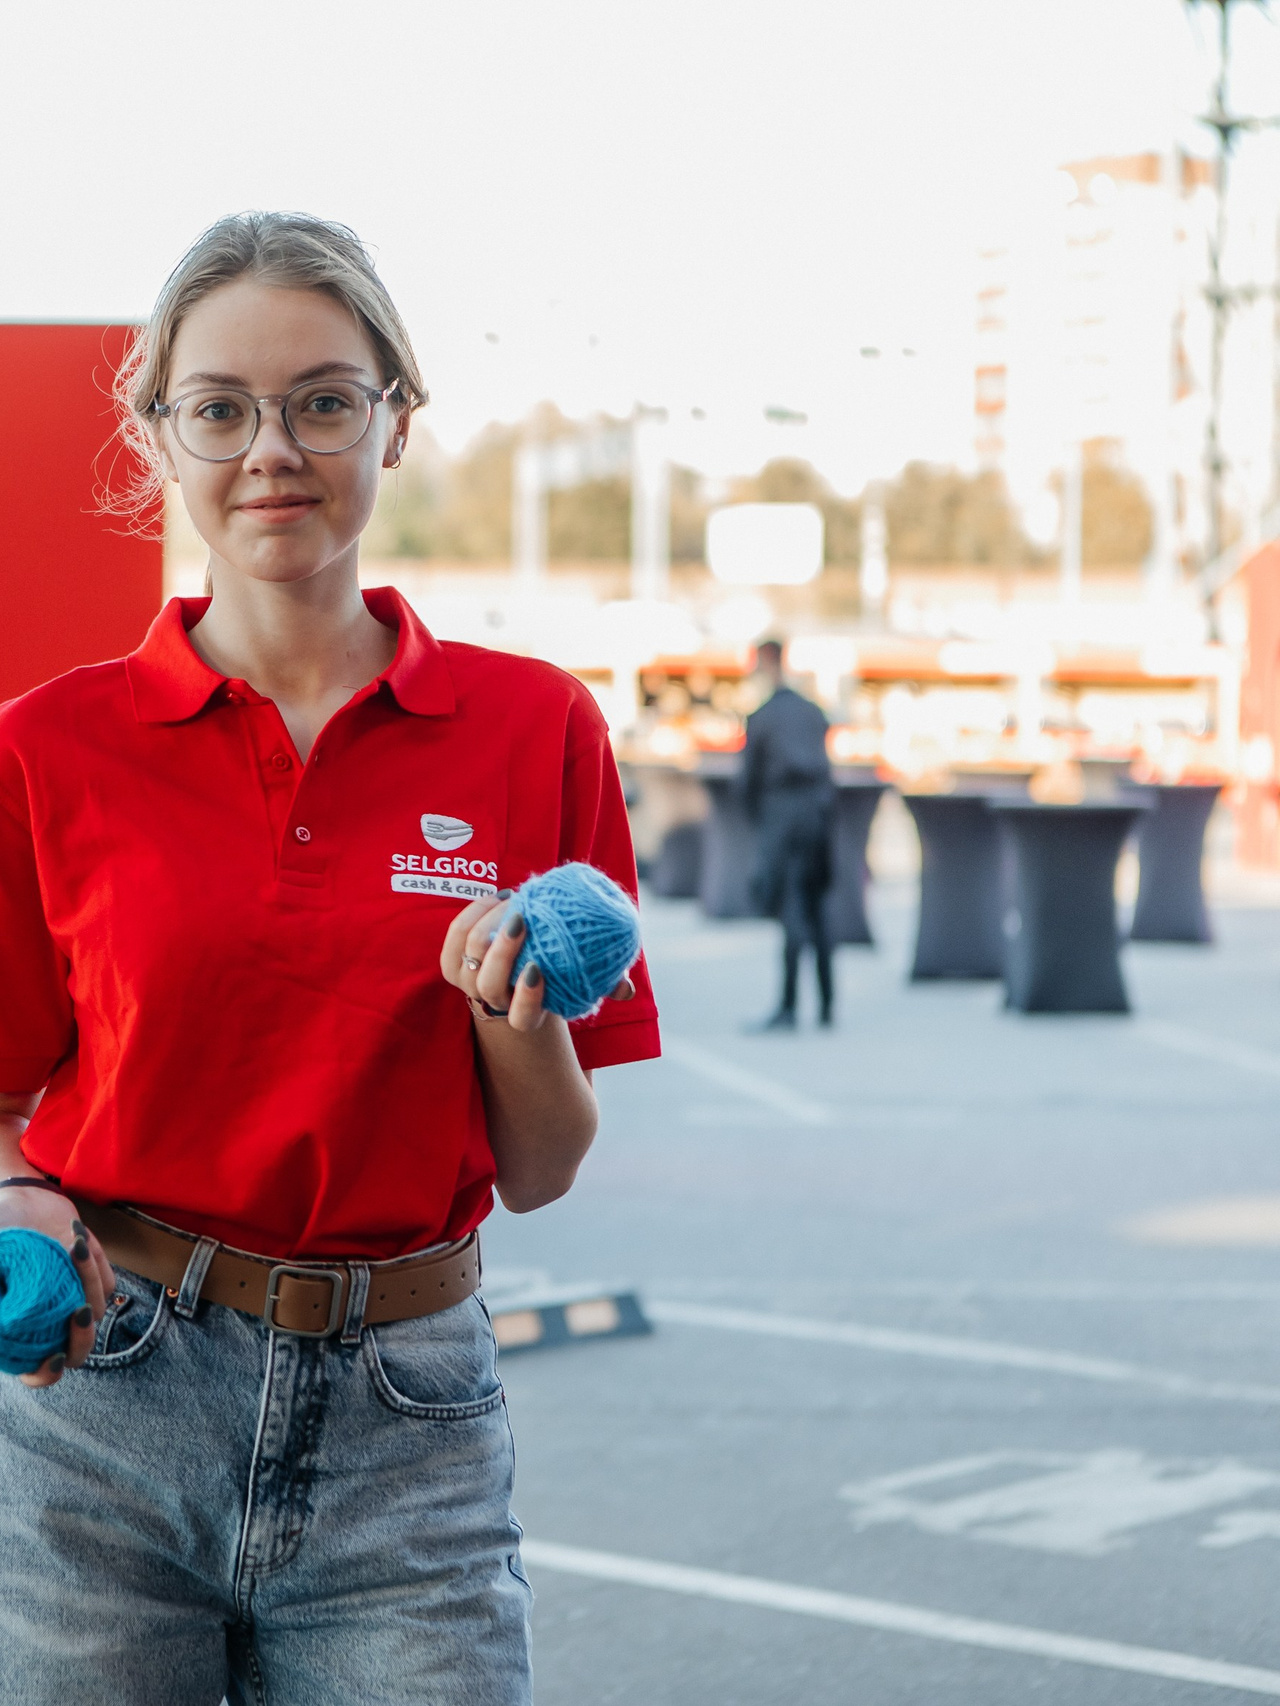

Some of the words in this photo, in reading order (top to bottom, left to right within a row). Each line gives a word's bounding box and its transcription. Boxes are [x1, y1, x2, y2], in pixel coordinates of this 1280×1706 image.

[390, 853, 498, 881] SELGROS
[401, 879, 437, 891] cash
[440, 880, 453, 893] &
